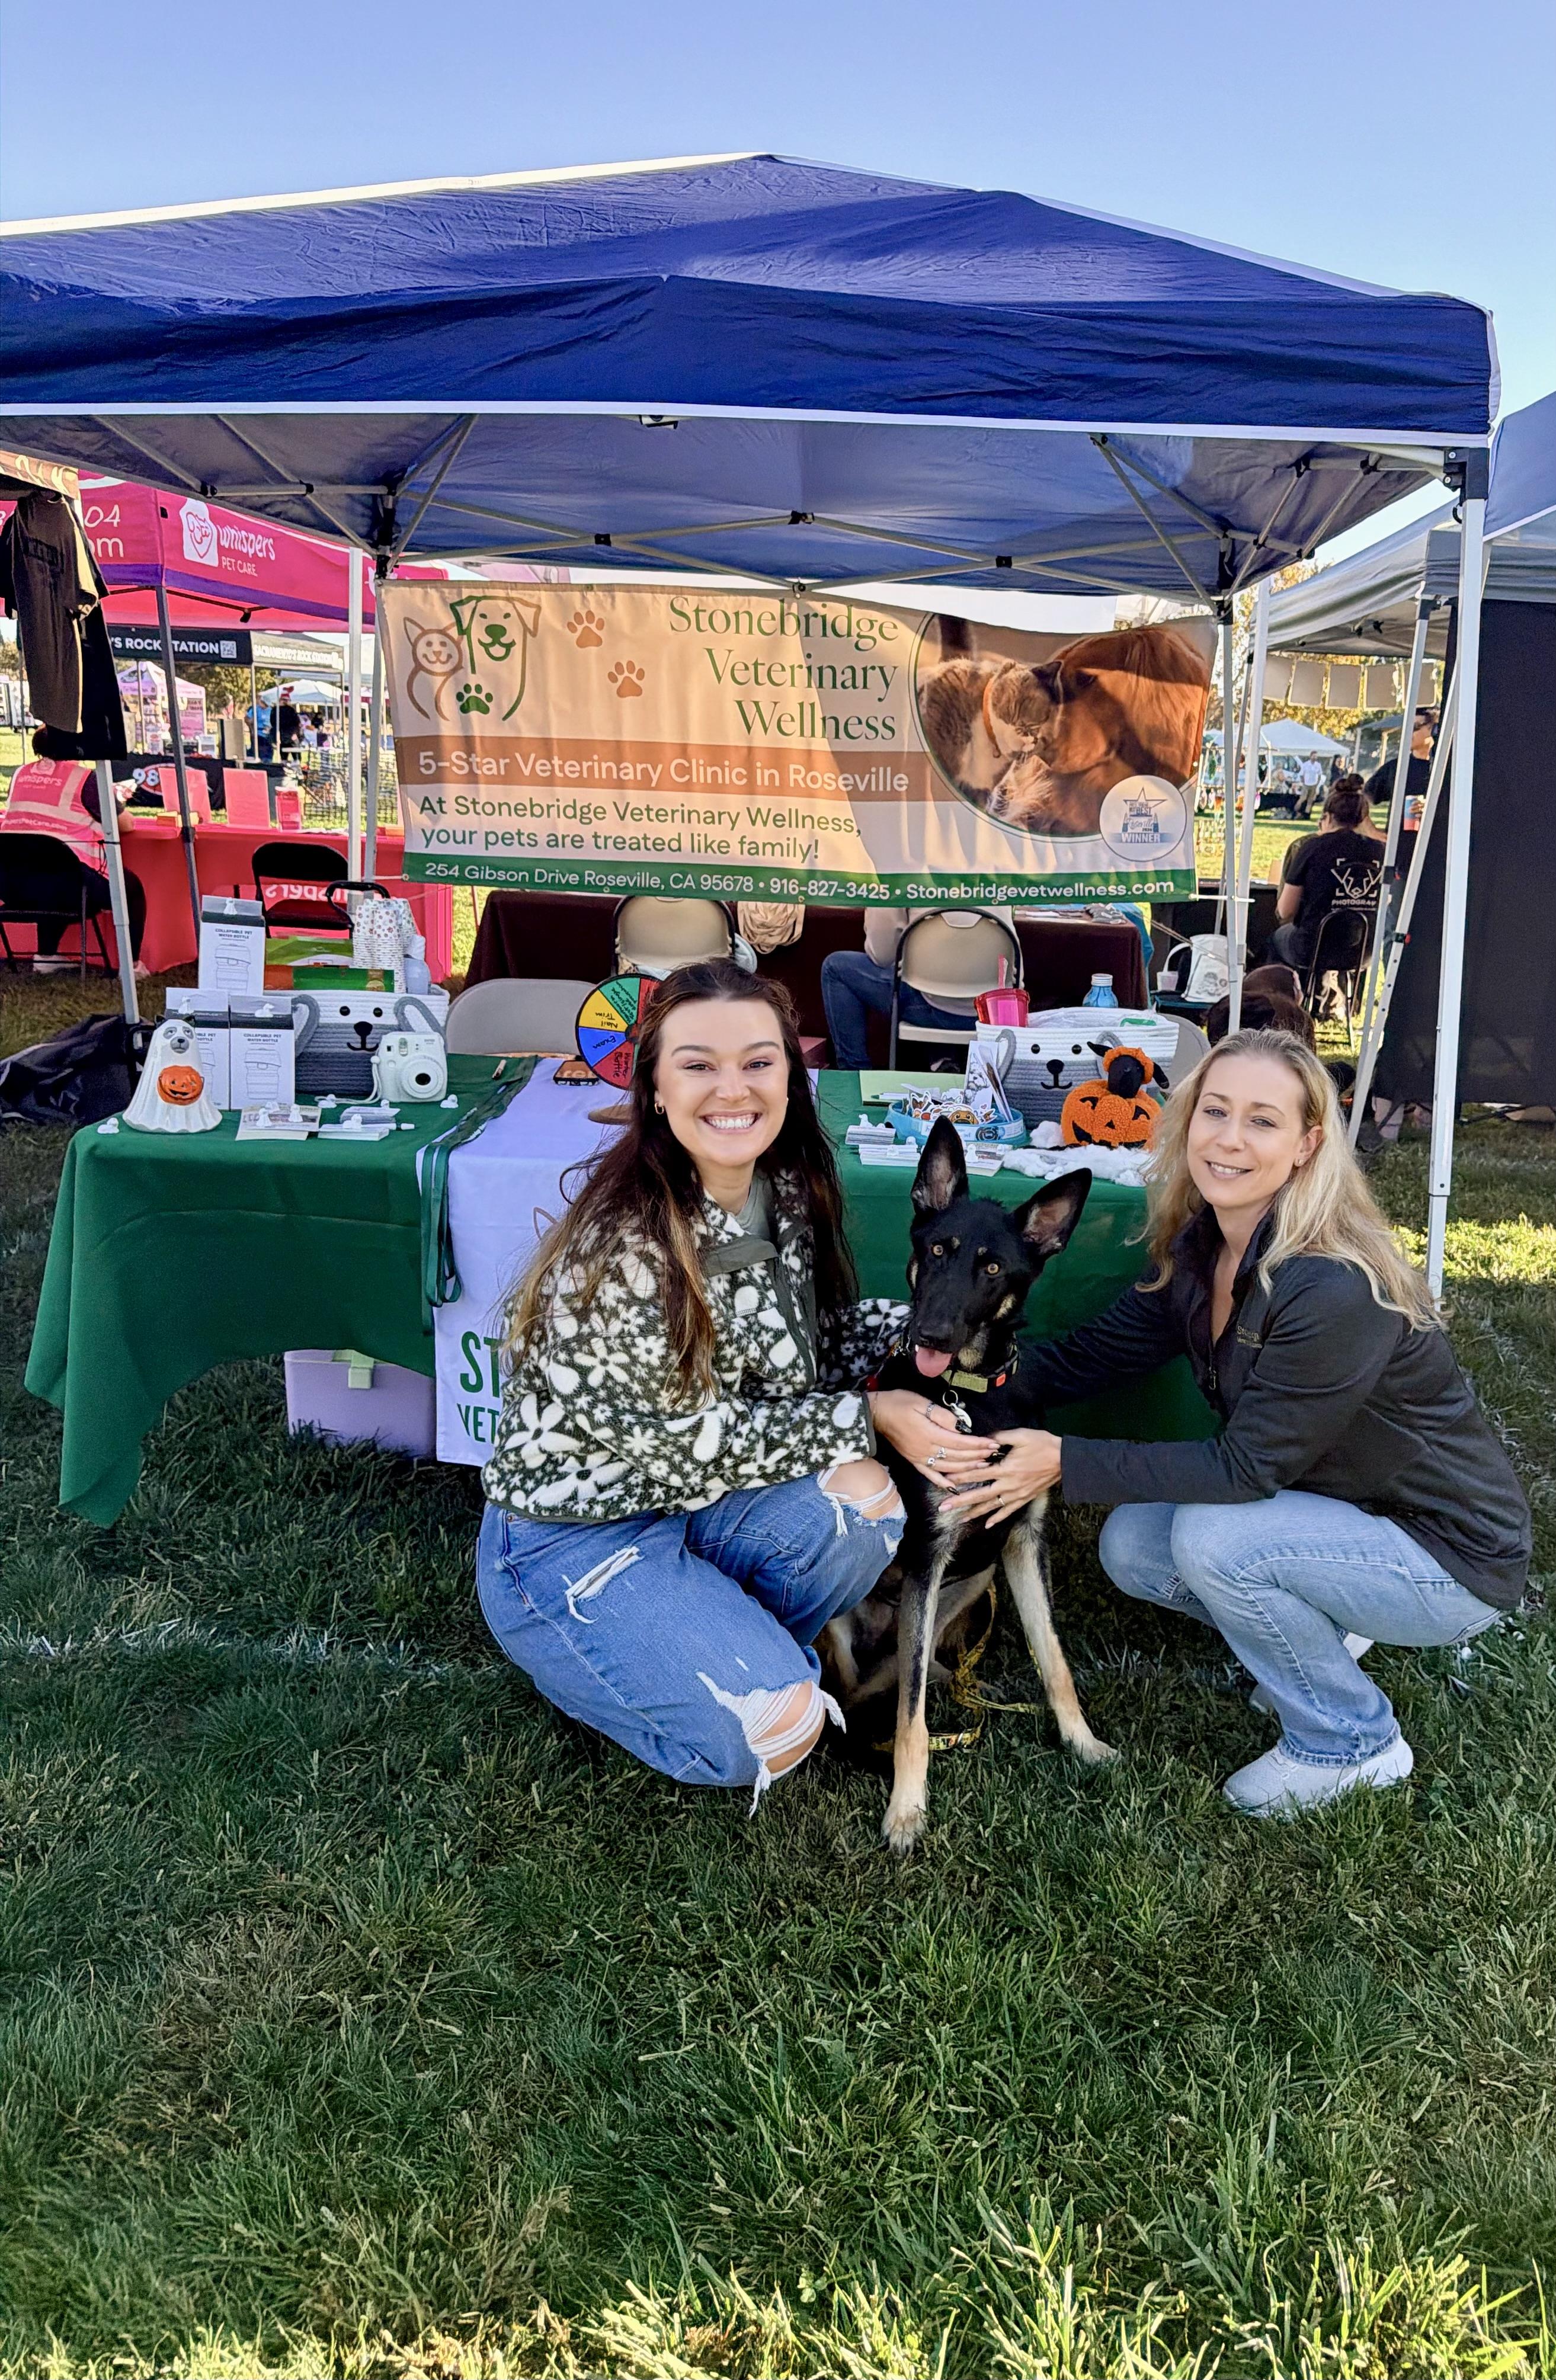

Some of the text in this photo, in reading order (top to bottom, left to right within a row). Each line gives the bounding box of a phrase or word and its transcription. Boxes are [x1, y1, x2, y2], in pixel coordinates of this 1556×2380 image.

[216, 524, 276, 561] whispers
[222, 556, 258, 577] PET CARE
[670, 596, 899, 652] Stonebridge
[125, 638, 162, 651] ROCK
[171, 640, 219, 654] TATION
[705, 648, 899, 703] Veterinary
[735, 700, 896, 740] Wellness
[419, 750, 909, 792] 5-Star Veterinary Clinic in Roseville
[420, 795, 862, 837] At Stonebridge Veterinary Wellness,
[1136, 806, 1152, 815] BEST
[421, 827, 819, 863] your pets are treated like family!
[1122, 832, 1160, 843] WINNER
[425, 862, 1174, 901] 254 Gibson Drive Roseville, CA 95678 916-827-3425 Stonebridgevetwellness.com
[595, 1011, 616, 1021] Trim
[600, 1020, 619, 1029] Nail
[593, 1035, 617, 1049] Exam
[613, 1050, 623, 1078] Bottle
[623, 1052, 632, 1080] Water
[456, 1402, 500, 1444] VET
